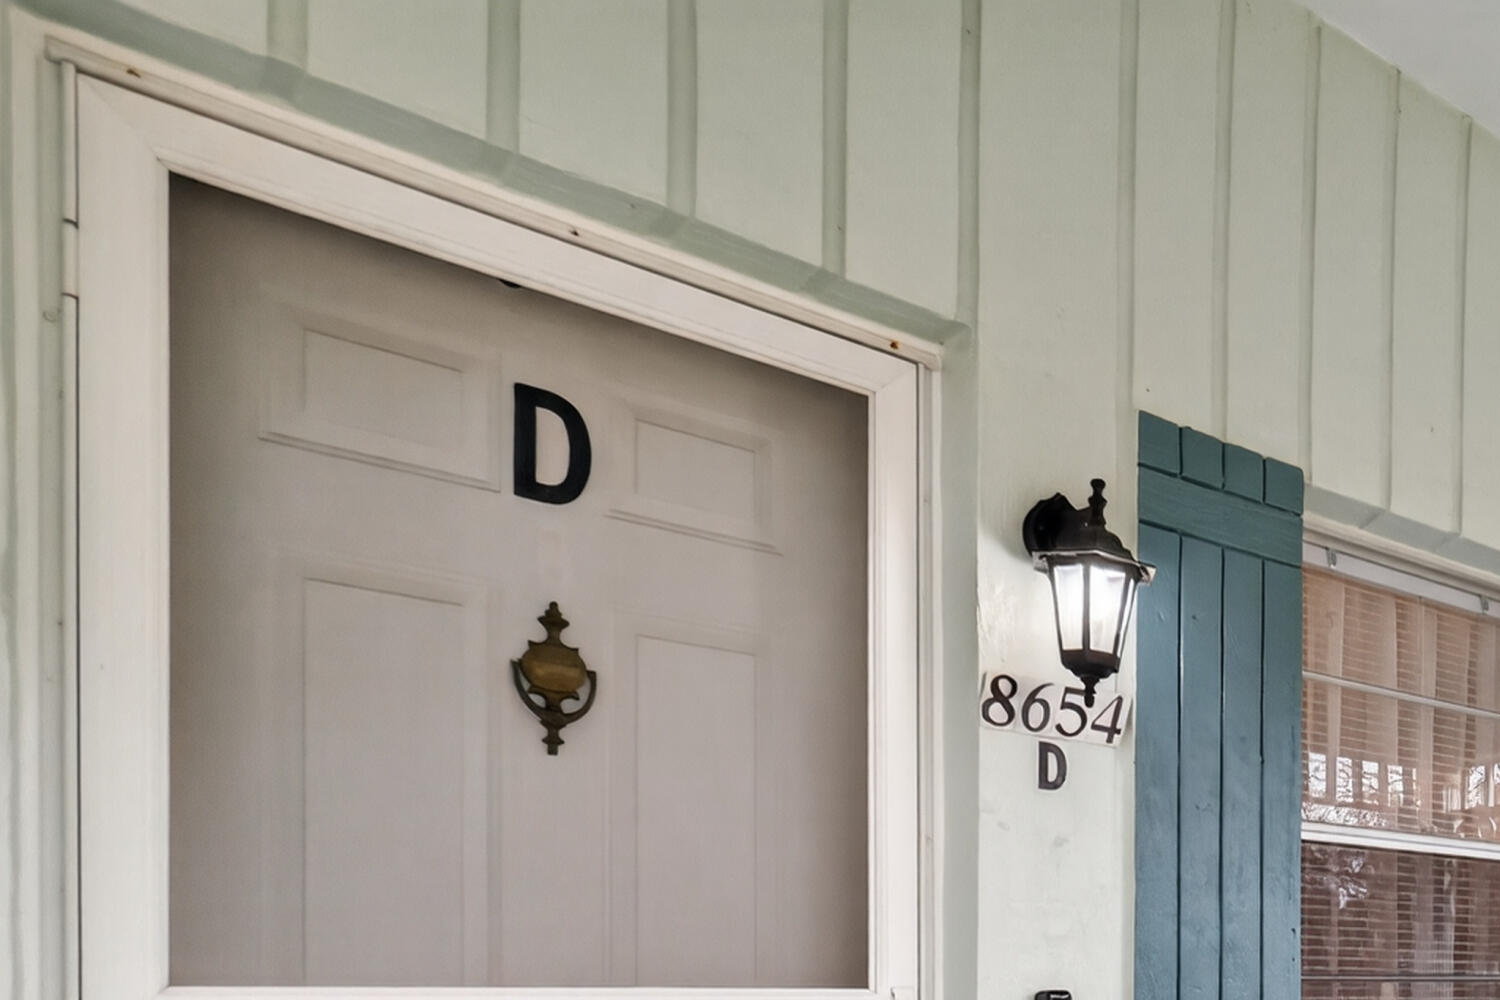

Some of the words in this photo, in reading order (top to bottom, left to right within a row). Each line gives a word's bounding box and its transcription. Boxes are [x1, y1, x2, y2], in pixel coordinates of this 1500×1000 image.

[514, 382, 592, 505] D
[982, 674, 1124, 744] 8654
[1038, 741, 1067, 790] D
